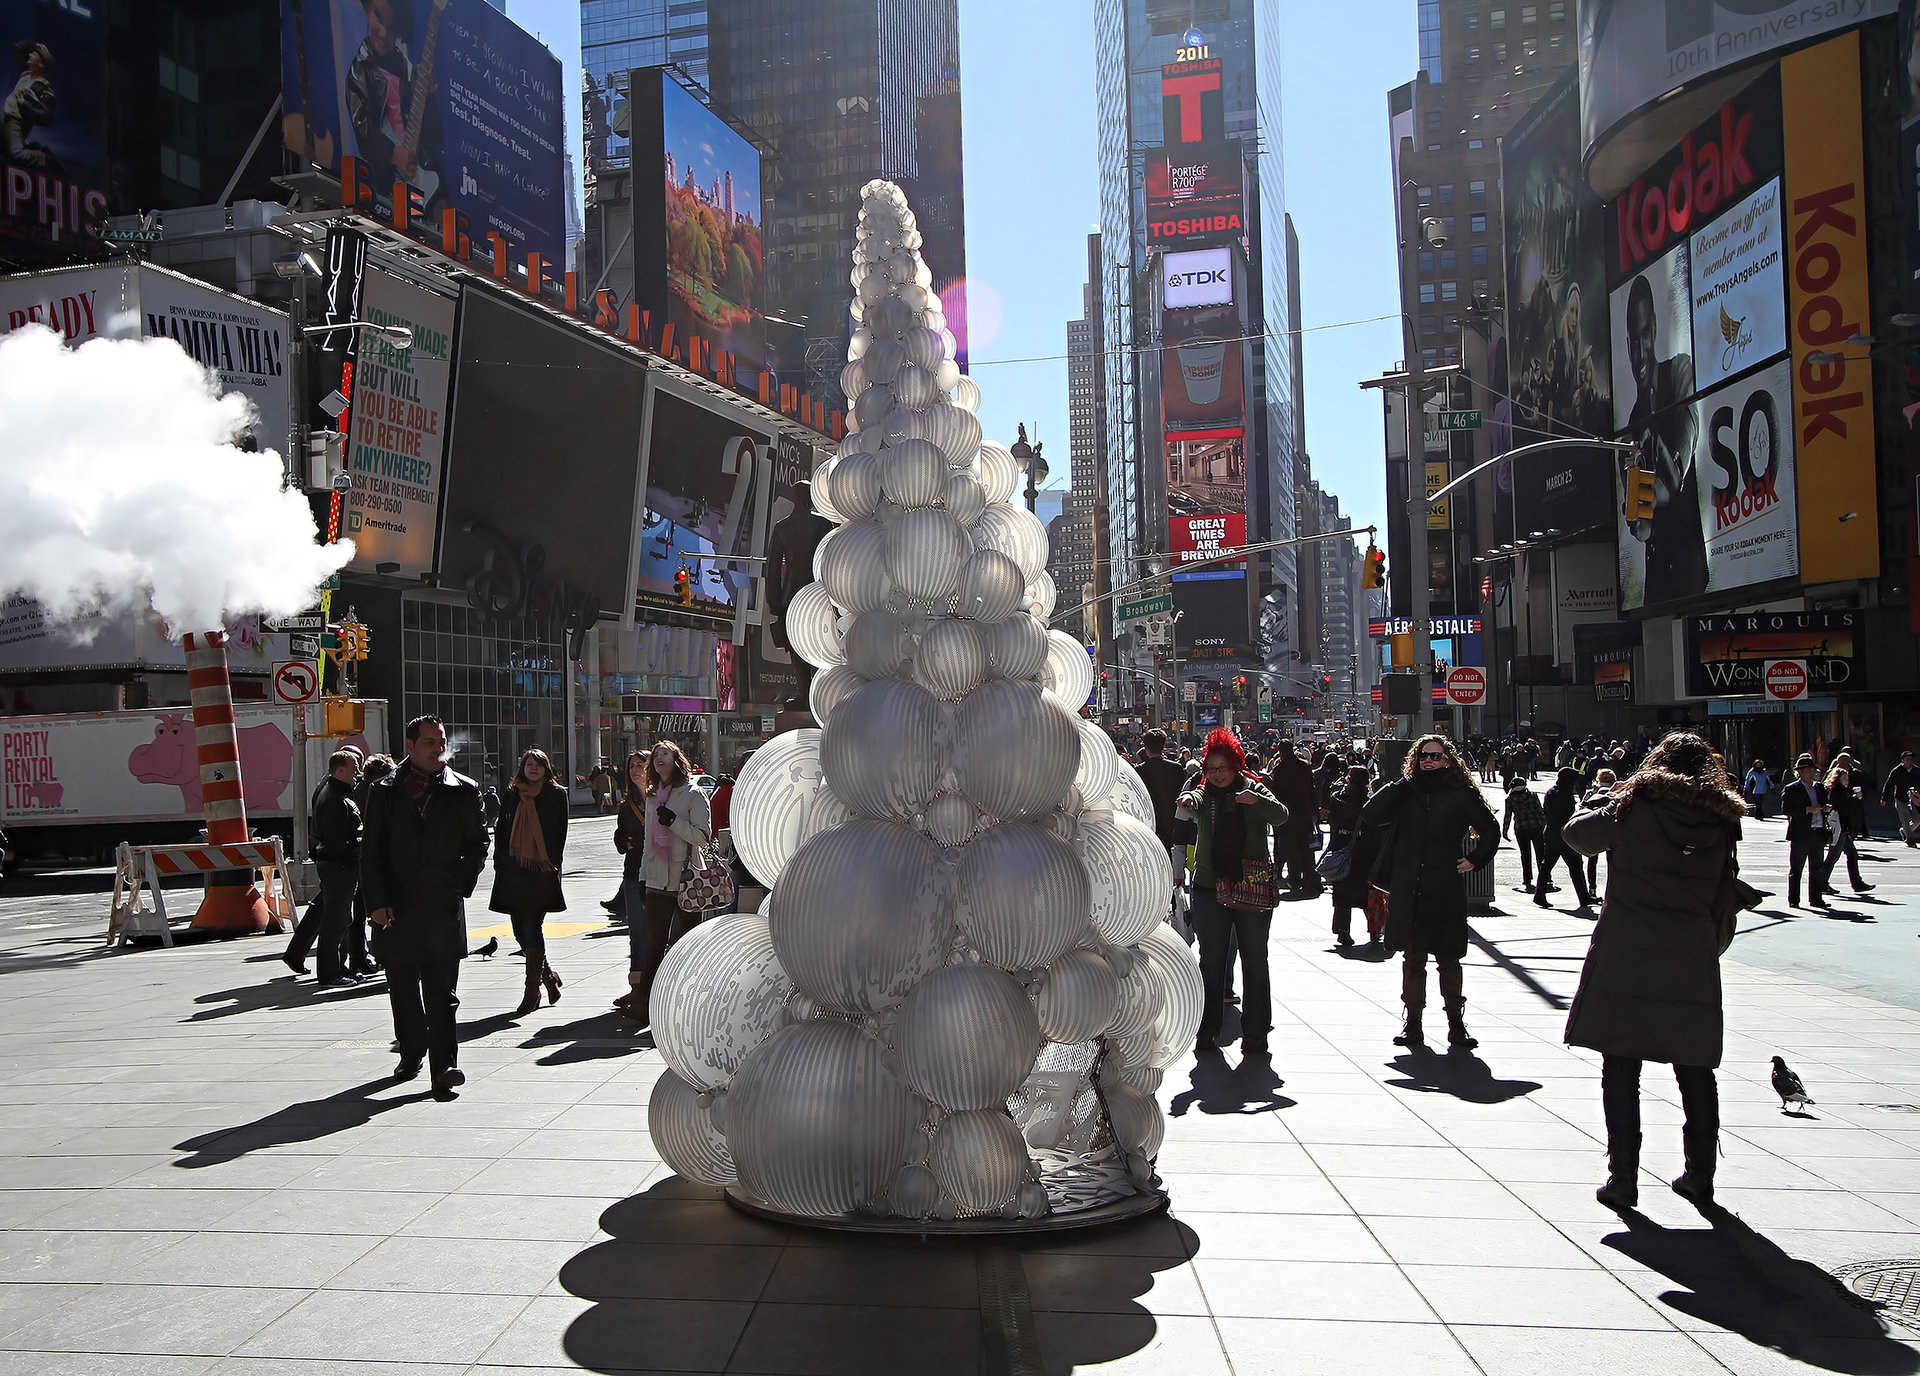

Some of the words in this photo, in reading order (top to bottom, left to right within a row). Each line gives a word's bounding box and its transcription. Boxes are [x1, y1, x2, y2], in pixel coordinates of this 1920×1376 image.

[1667, 46, 1709, 79] 10th
[1716, 0, 1866, 57] Anniversary
[1176, 46, 1209, 62] 2011
[1164, 58, 1221, 75] TOSHIBA
[1162, 72, 1220, 144] T
[450, 101, 470, 123] Test.
[472, 114, 510, 148] Diagnose.
[1172, 164, 1206, 178] PORTÉGÉ
[1172, 176, 1195, 189] R700
[1617, 101, 1757, 272] Kodak
[1150, 214, 1242, 238] TOSHIBA
[1695, 229, 1729, 257] Become
[1731, 217, 1742, 234] an
[1742, 186, 1777, 233] official
[100, 228, 157, 240] LAMAR
[1702, 247, 1736, 280] member
[1737, 239, 1756, 259] now
[1757, 225, 1768, 244] at
[1182, 269, 1227, 286] TDK
[1695, 250, 1779, 308] www.TreysAngels.com
[188, 308, 217, 321] ANDERSSON
[1793, 182, 1864, 448] Kodak
[147, 313, 236, 372] MAMMA
[236, 325, 282, 377] MIA!
[414, 324, 448, 359] MADE
[379, 340, 415, 375] HERE.
[360, 361, 388, 392] BUT
[391, 373, 421, 404] WILL
[359, 389, 385, 420] YOU
[388, 399, 404, 426] BE
[406, 404, 438, 435] ABLE
[1441, 414, 1449, 428] W
[1453, 413, 1466, 428] 46
[1470, 412, 1479, 421] ST
[357, 417, 375, 445] TO
[377, 423, 422, 458] RETIRE
[1708, 389, 1782, 508] SO
[779, 441, 800, 465] NYC's
[354, 445, 432, 486] ANYWHERE?
[352, 474, 368, 491] ASK
[370, 477, 389, 496] TEAM
[391, 483, 436, 505] RETIREMENT.
[1545, 473, 1565, 492] MARCH
[1565, 469, 1573, 484] 25
[350, 492, 402, 514] 800-290-0500
[1715, 467, 1780, 531] Kodak
[351, 514, 362, 530] TD
[364, 517, 407, 534] Ameritrade
[1188, 518, 1226, 530] GREAT
[1190, 529, 1226, 541] TIMES
[1196, 540, 1220, 550] ARE
[1710, 546, 1724, 557] SHARE
[1724, 543, 1734, 553] YOUR
[1740, 538, 1754, 549] KODAK
[1754, 533, 1773, 544] MOMENT
[1773, 529, 1786, 541] HERE
[1565, 588, 1613, 601] Marriott
[1126, 601, 1165, 617] Broadway
[270, 618, 290, 627] ONE
[298, 618, 318, 627] WAY
[1385, 617, 1474, 636] AÉROSTALE
[1699, 613, 1854, 632] MARQUIS
[294, 641, 304, 650] ONE
[1195, 638, 1226, 646] SONY
[1214, 663, 1241, 671] Optima
[1774, 685, 1798, 693] ENTER
[657, 714, 693, 733] FOREVER
[4, 730, 49, 757] PARTY
[5, 757, 58, 783] RENTAL
[6, 783, 36, 809] LTD.
